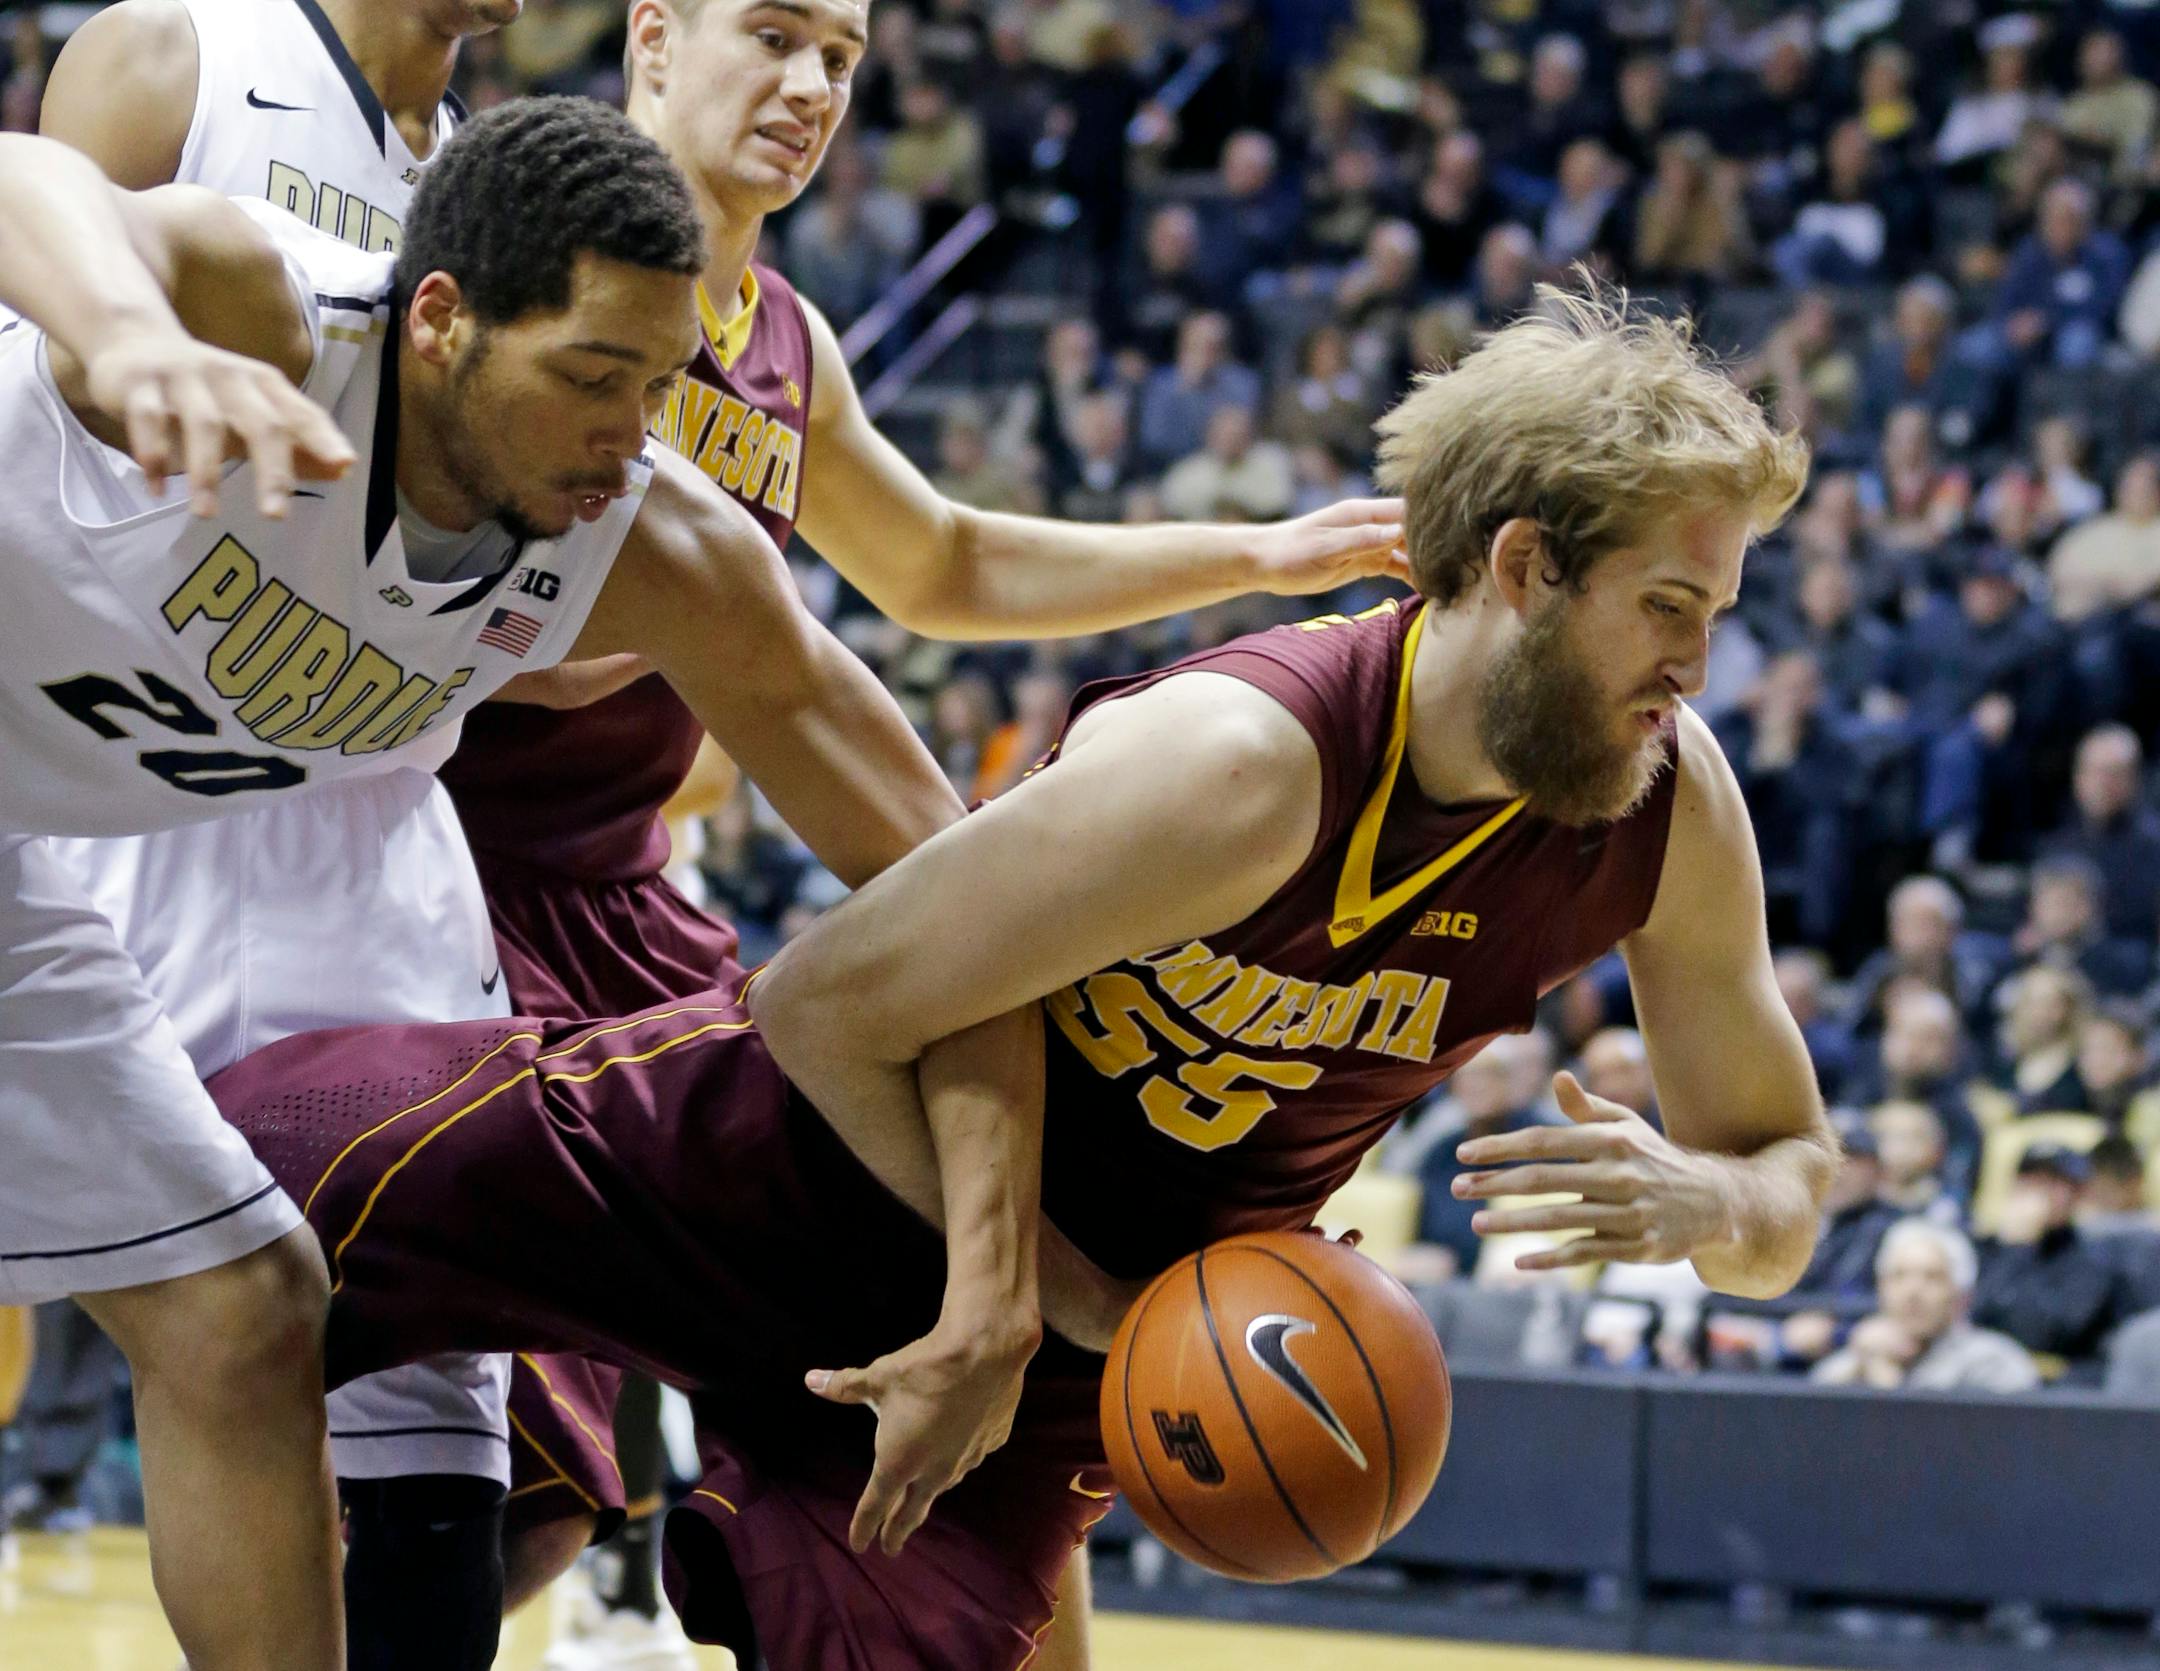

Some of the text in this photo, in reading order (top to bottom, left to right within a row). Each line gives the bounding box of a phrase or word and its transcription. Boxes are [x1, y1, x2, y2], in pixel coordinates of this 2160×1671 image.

[161, 532, 476, 755] PURDUE
[36, 667, 308, 796] 20
[1046, 971, 1324, 1153] 55
[1127, 939, 1451, 1064] INNESOTA
[1151, 1410, 1225, 1485] P
